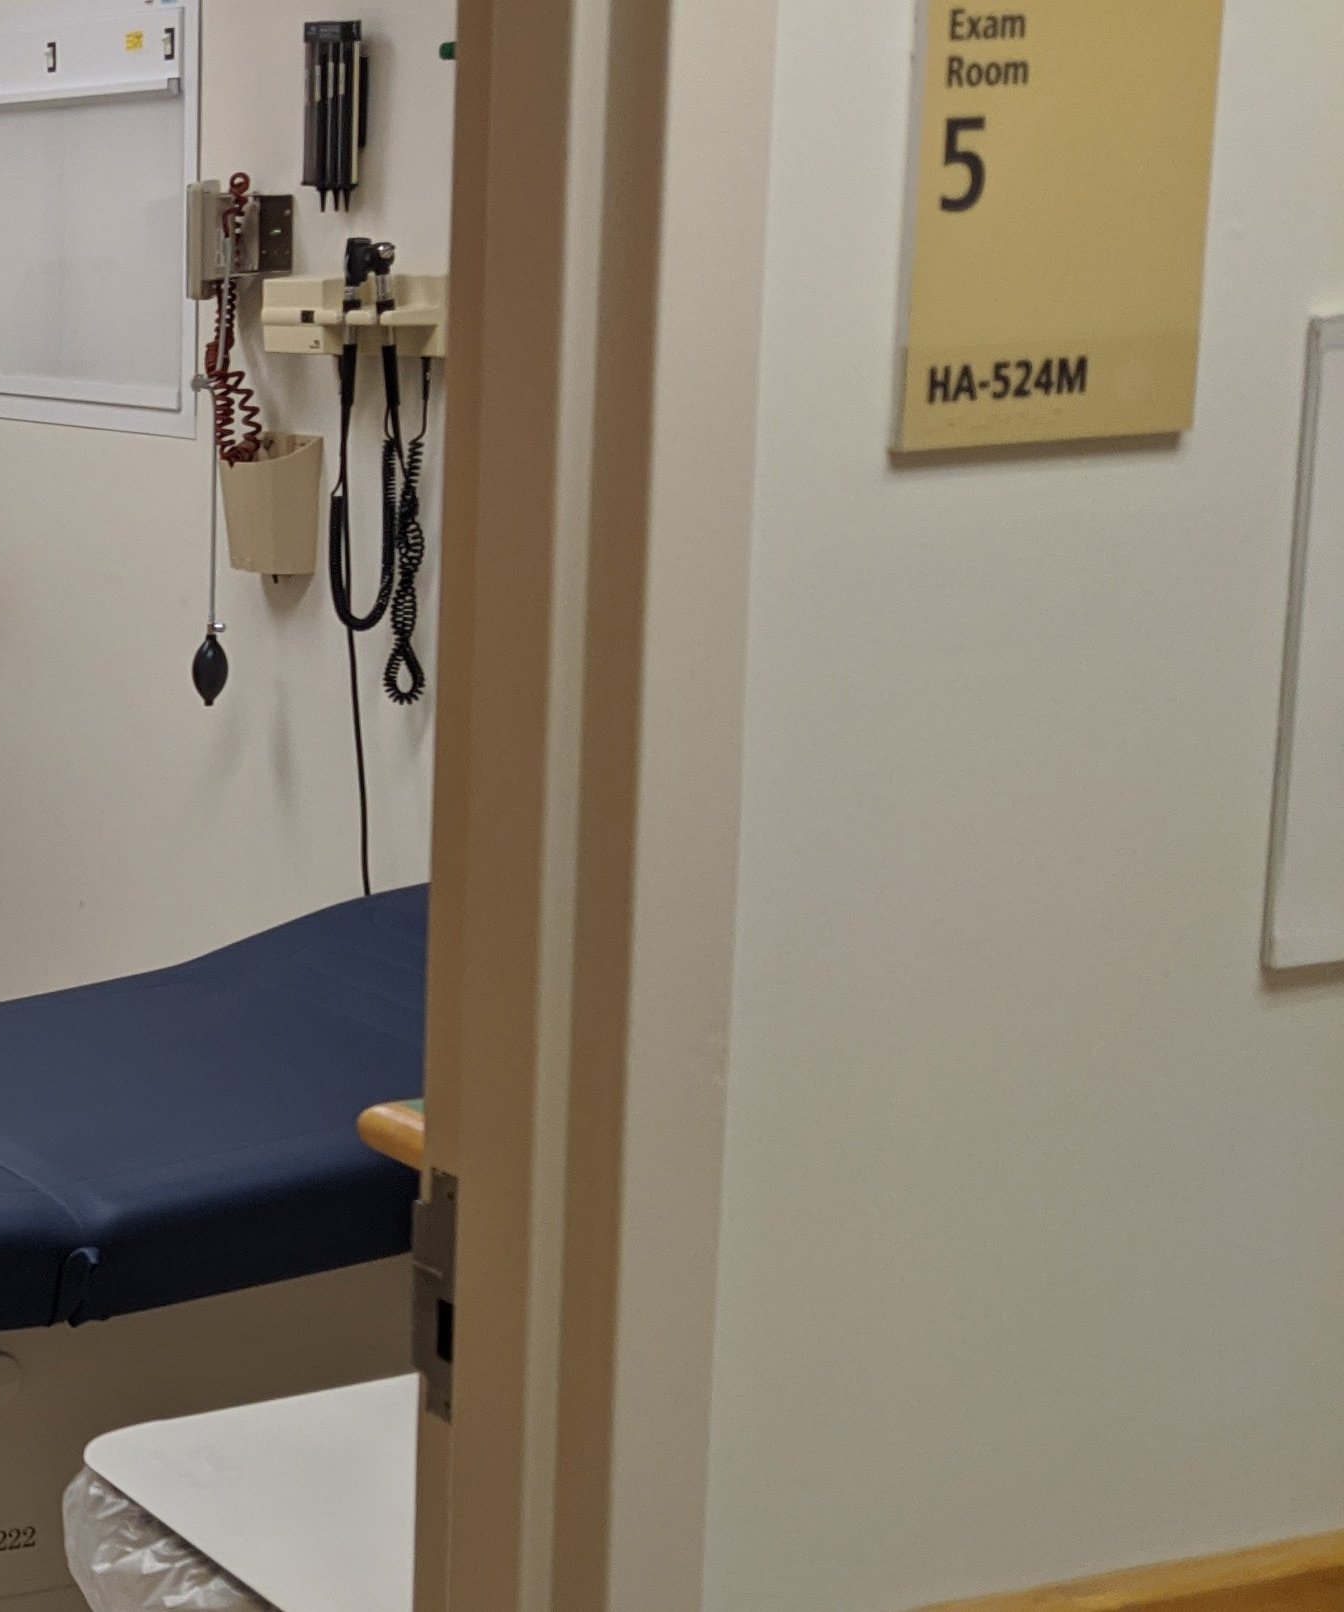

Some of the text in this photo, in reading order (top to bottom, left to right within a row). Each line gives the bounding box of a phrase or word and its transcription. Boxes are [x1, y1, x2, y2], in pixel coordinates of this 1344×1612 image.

[948, 8, 1027, 42] Exam
[946, 55, 1029, 88] Room
[939, 115, 987, 213] 5
[926, 355, 1089, 405] HA-524M
